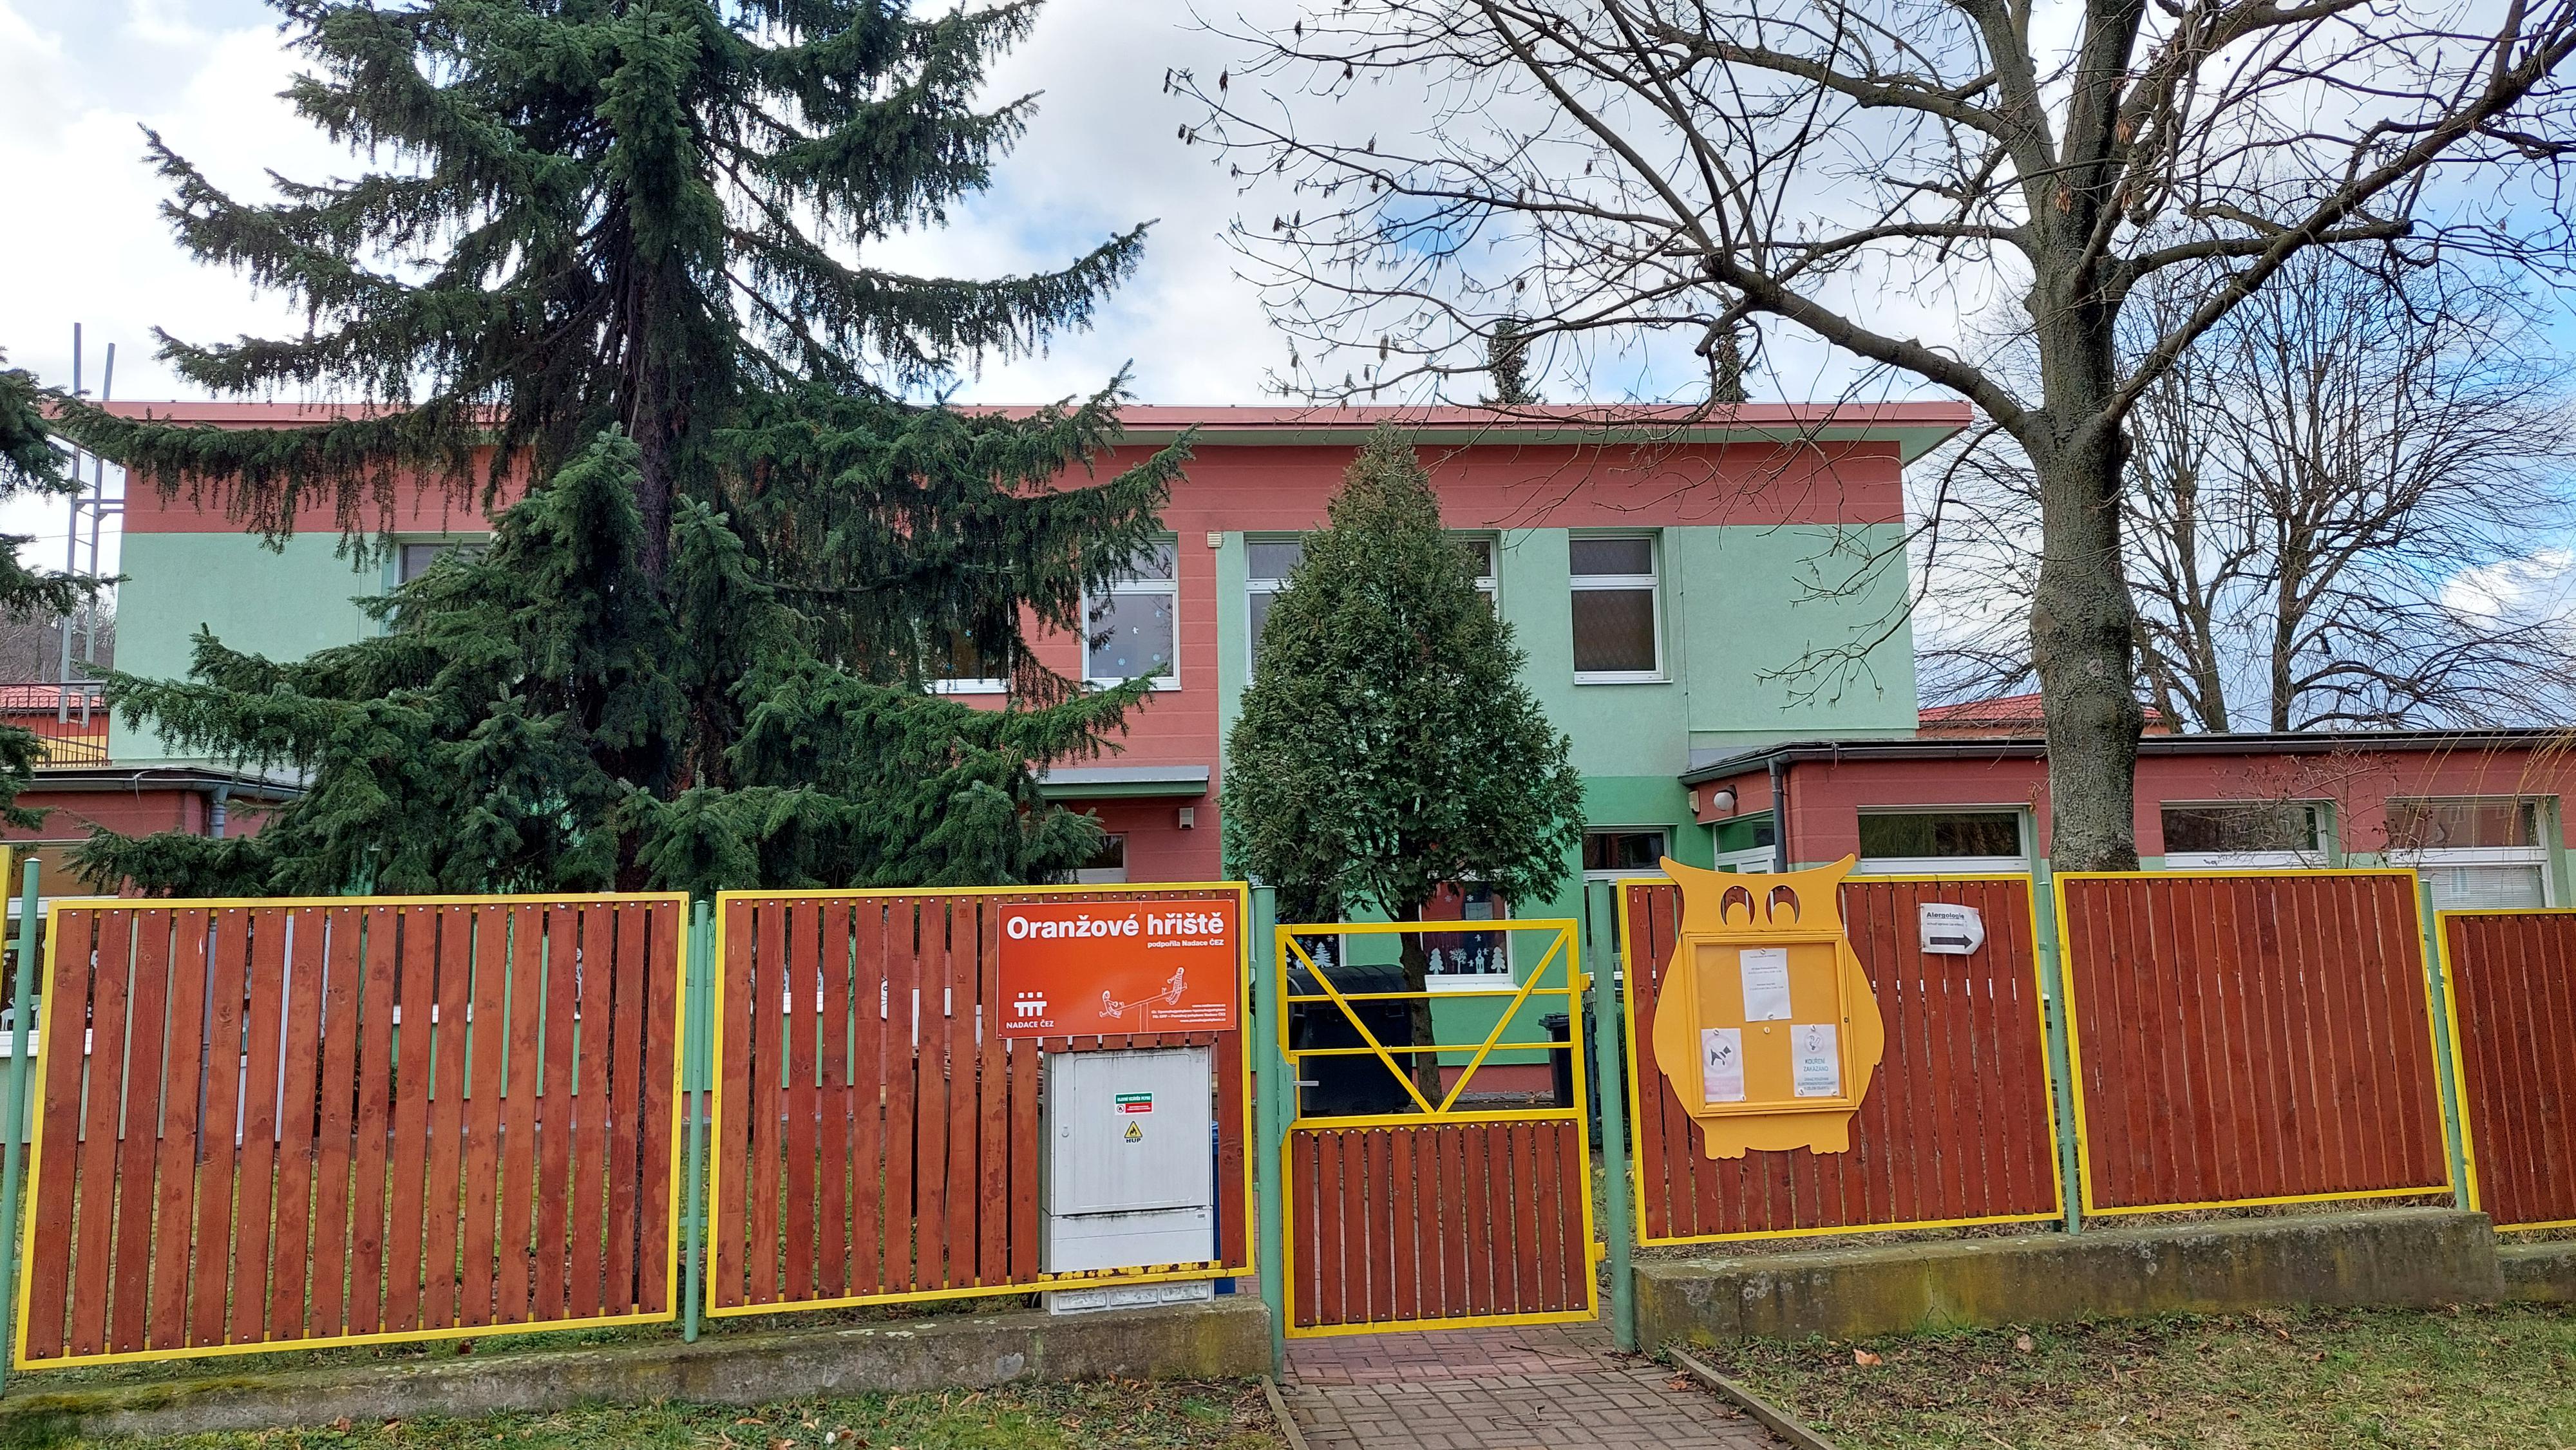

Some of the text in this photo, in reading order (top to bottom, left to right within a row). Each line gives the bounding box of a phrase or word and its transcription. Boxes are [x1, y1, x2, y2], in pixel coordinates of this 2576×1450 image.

[1007, 912, 1224, 939] Oranžové hřiště
[1147, 940, 1180, 948] podpořila
[1040, 1019, 1054, 1028] ČEZ
